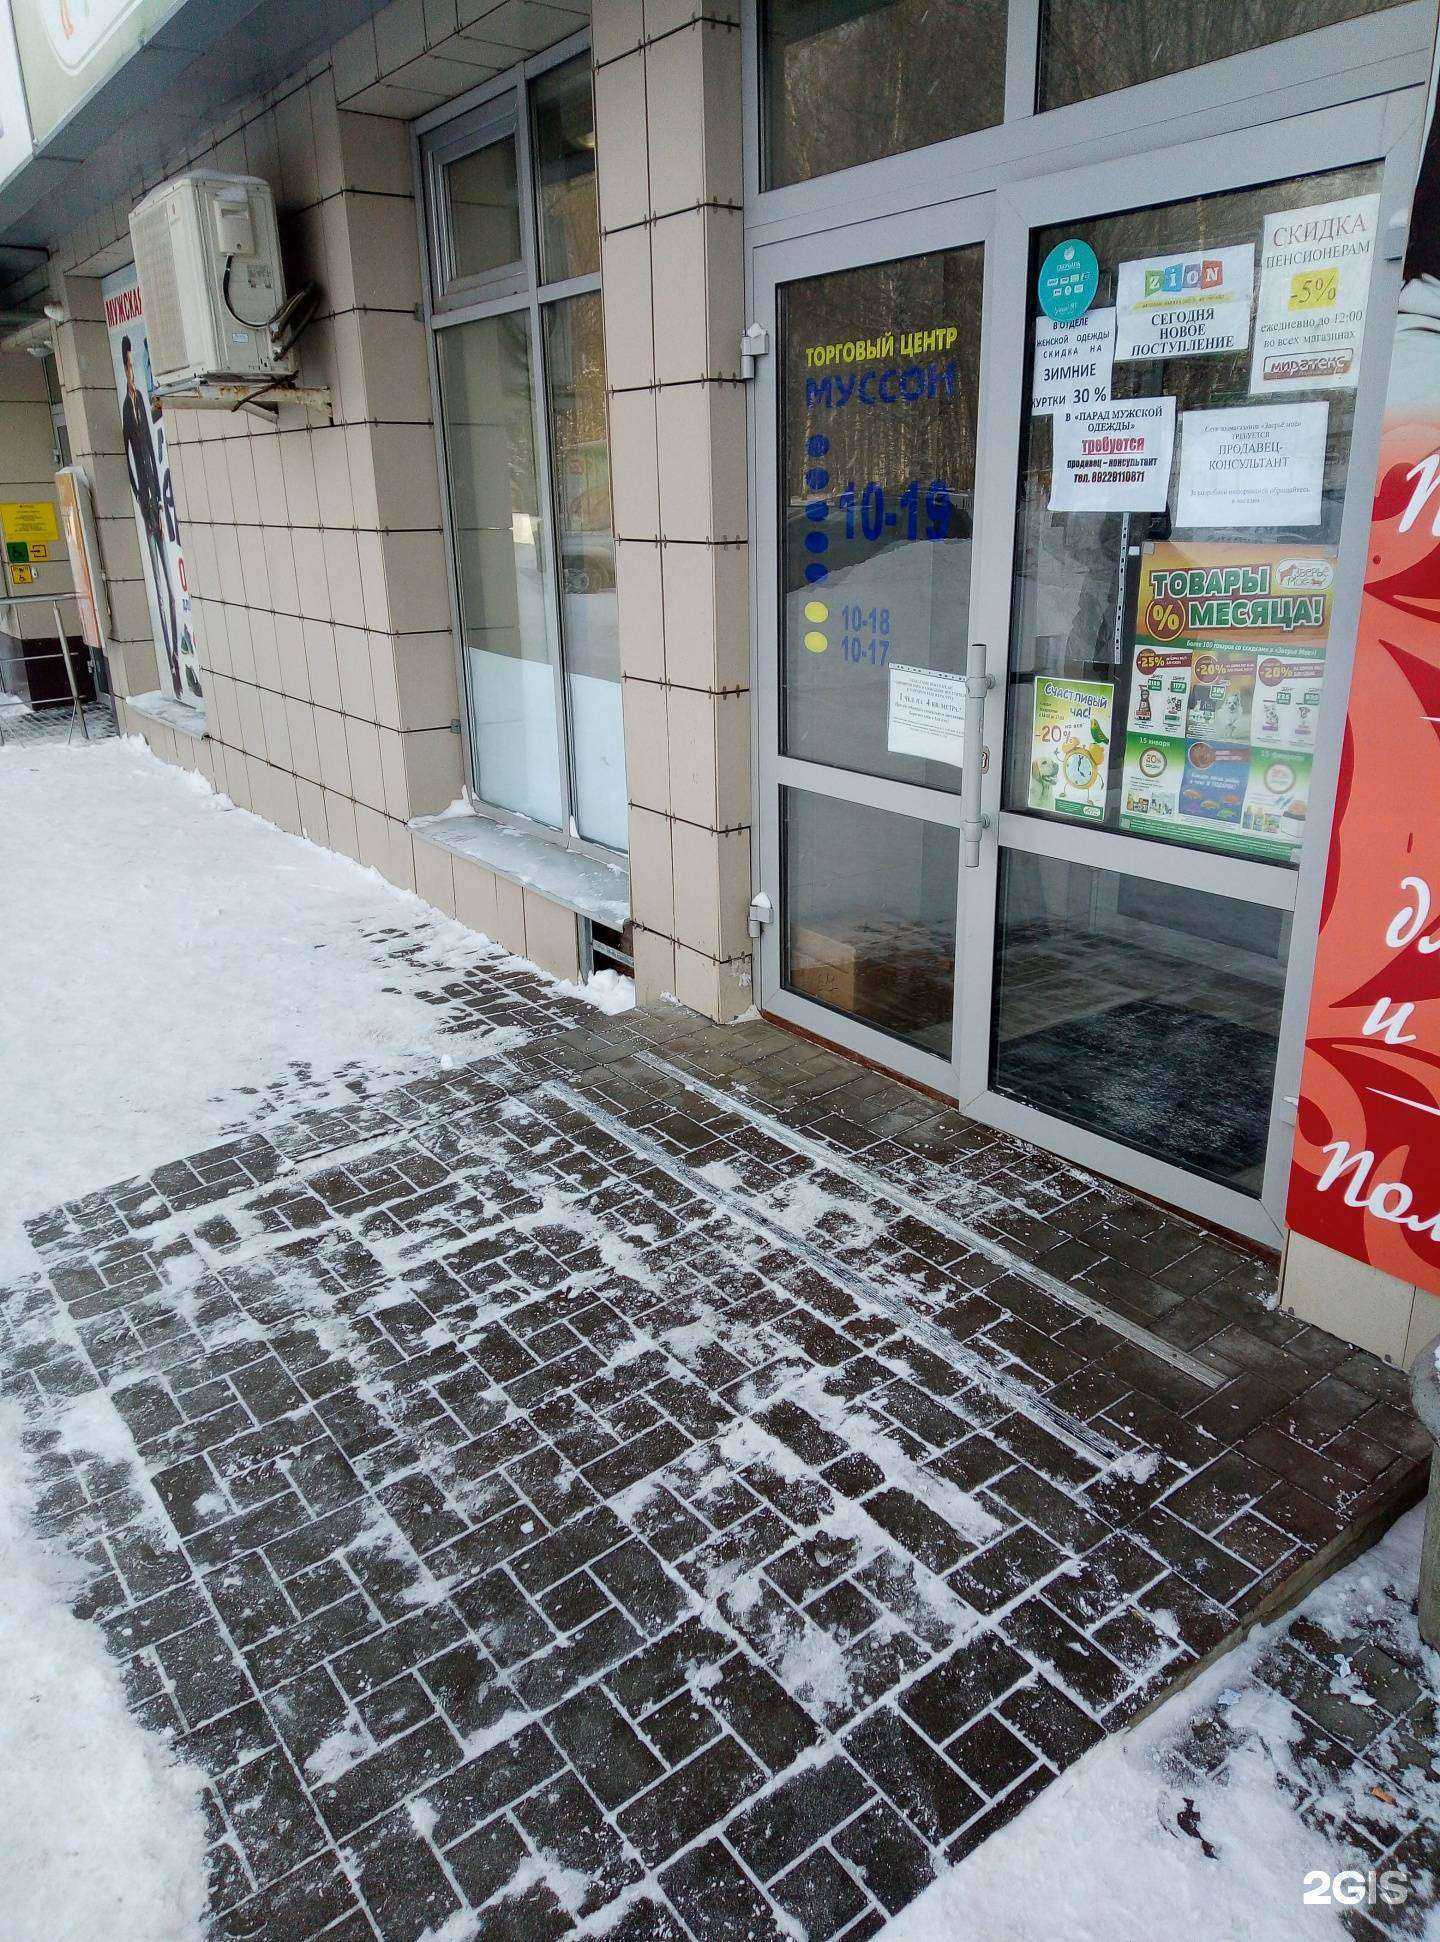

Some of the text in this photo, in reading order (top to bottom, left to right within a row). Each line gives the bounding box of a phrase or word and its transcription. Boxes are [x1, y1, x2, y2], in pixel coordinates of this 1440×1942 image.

[1273, 213, 1366, 247] СКИДКА
[1266, 240, 1371, 269] ПЕНСИОНЕРАМ
[1291, 270, 1337, 304] -5%
[1151, 307, 1215, 326] СЕГОДНЯ
[1260, 310, 1363, 333] ежедневно до 12:00
[1036, 331, 1110, 347] ЖЕНСКОЙ ОДЕЖДЫ
[1159, 323, 1206, 340] НОВОЕ
[1263, 332, 1355, 349] во всех магазинах
[805, 326, 958, 367] ТОРГОВЫЙ ЦЕНТР
[1043, 344, 1102, 359] СКИДКА НА
[1131, 335, 1235, 356] ПОСТУПЛЕНИЕ
[1043, 363, 1097, 382] ЗИМНИЕ
[805, 360, 957, 409] МУССОН
[1073, 388, 1090, 404] 30
[1094, 386, 1107, 403] %
[1065, 406, 1163, 422] В «ПАРАД МУЖСКОЙ
[1087, 421, 1136, 433] ОДЕЖДЫ»
[1082, 436, 1145, 455] требуется
[1218, 441, 1284, 455] ПРОДАВЕЦ-
[1208, 456, 1291, 471] КОНСУЛЬТАНТ
[1074, 473, 1091, 484] тел.
[839, 480, 951, 541] 10-19
[1151, 565, 1271, 599] ТОВАРЫ
[841, 605, 890, 636] 10-18
[1188, 596, 1325, 631] МЕСЯЦА!
[841, 635, 890, 667] 10-17
[1069, 706, 1092, 719] ЧАС!
[1361, 996, 1417, 1045] и
